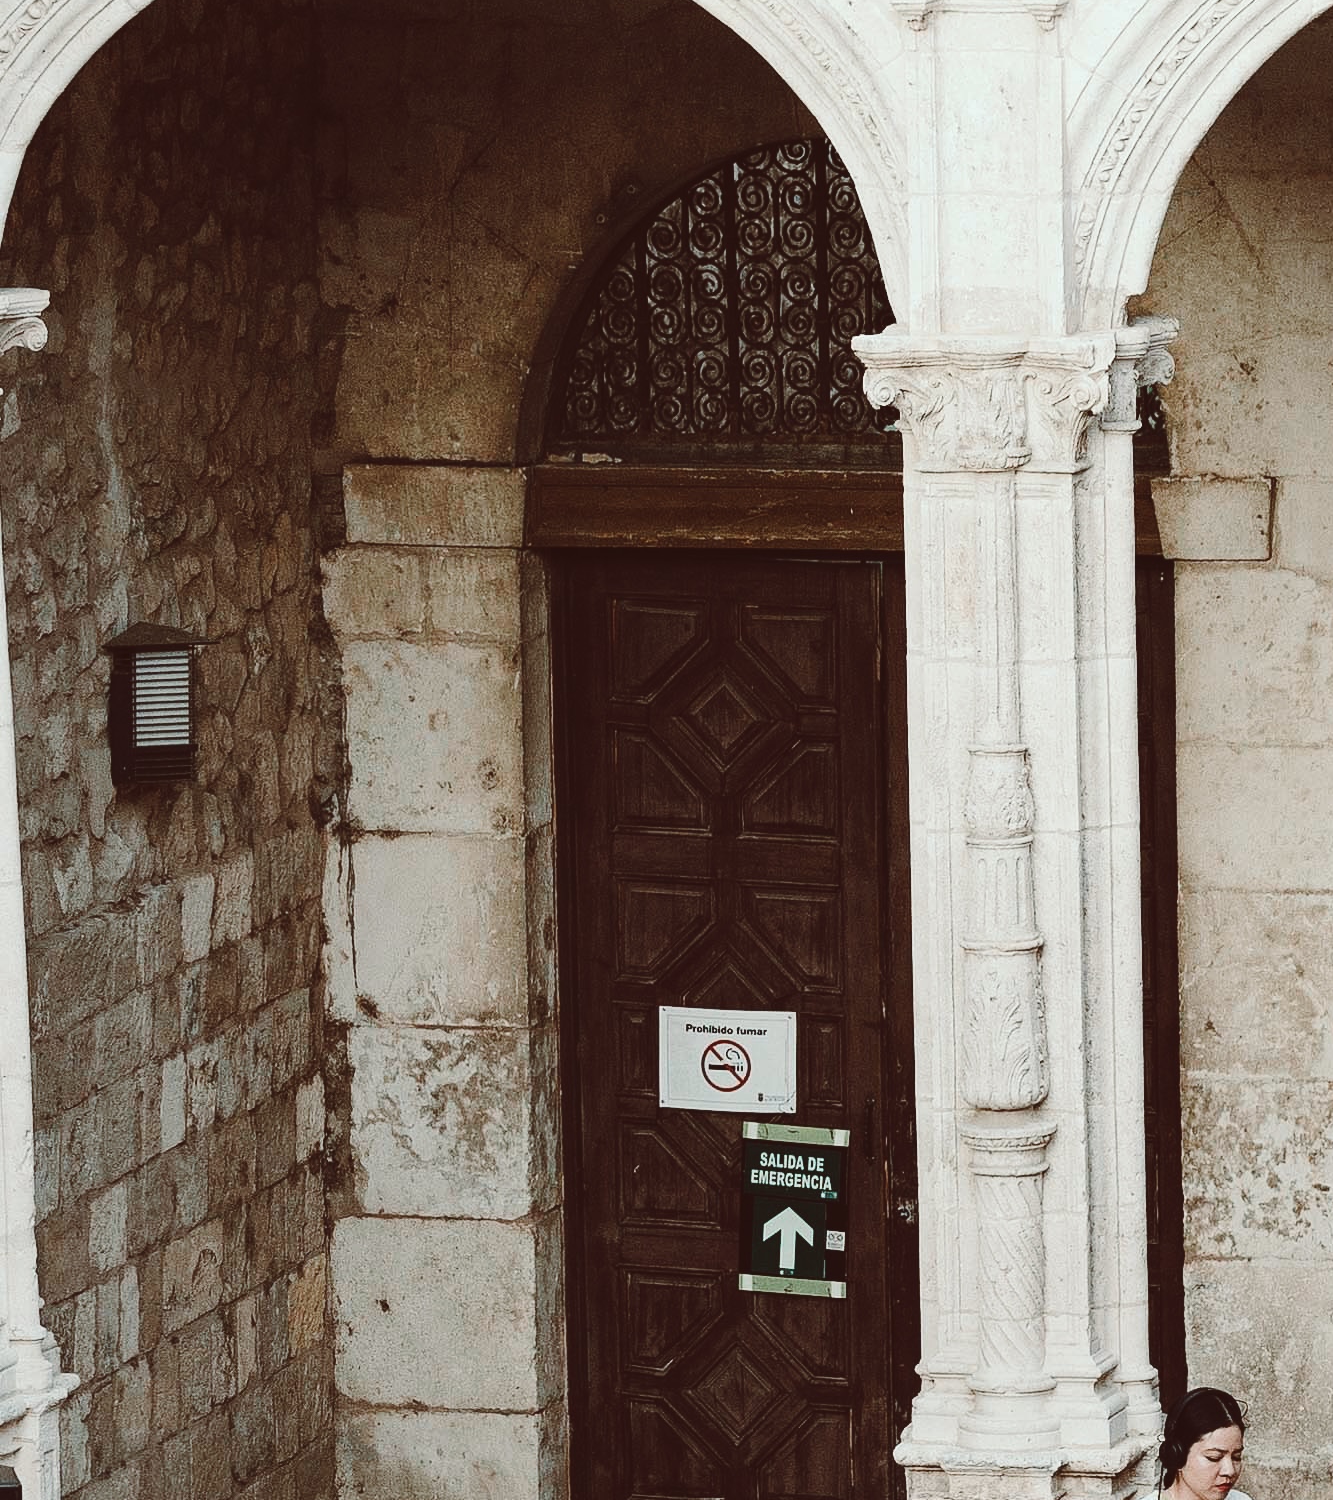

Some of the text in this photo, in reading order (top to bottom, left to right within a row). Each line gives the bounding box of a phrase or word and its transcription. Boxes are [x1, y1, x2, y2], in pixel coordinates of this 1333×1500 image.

[685, 1023, 768, 1036] Prohibido fumar
[760, 1151, 825, 1172] SALIDA DE
[750, 1168, 832, 1191] EMERGENCIA
